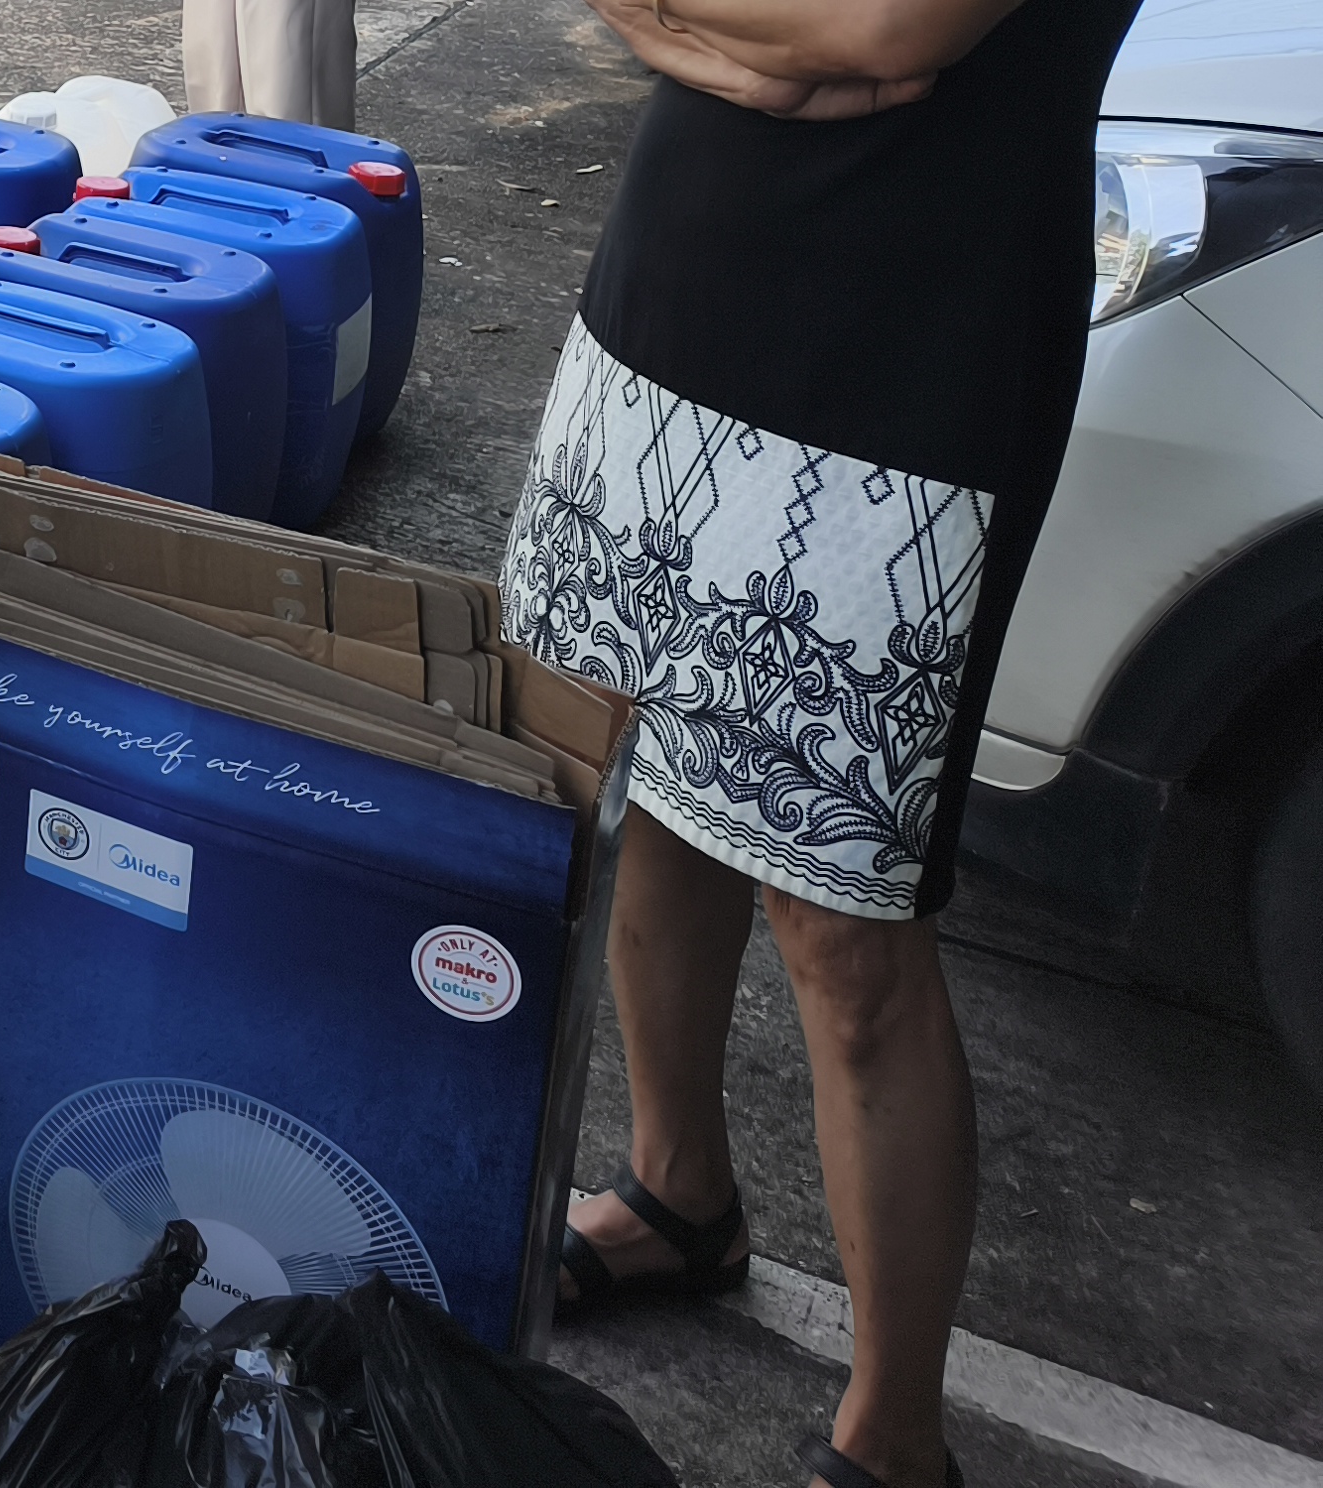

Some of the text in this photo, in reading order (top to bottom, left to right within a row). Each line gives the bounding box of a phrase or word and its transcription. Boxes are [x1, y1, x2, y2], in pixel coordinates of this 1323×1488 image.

[43, 702, 197, 774] yourself
[206, 754, 270, 782] at
[263, 762, 381, 814] home
[55, 847, 70, 857] CITY
[109, 843, 180, 887] Midea
[435, 956, 498, 984] makro
[479, 949, 498, 964] AT
[432, 977, 495, 1006] Lotus's
[194, 1265, 253, 1302] Midea
